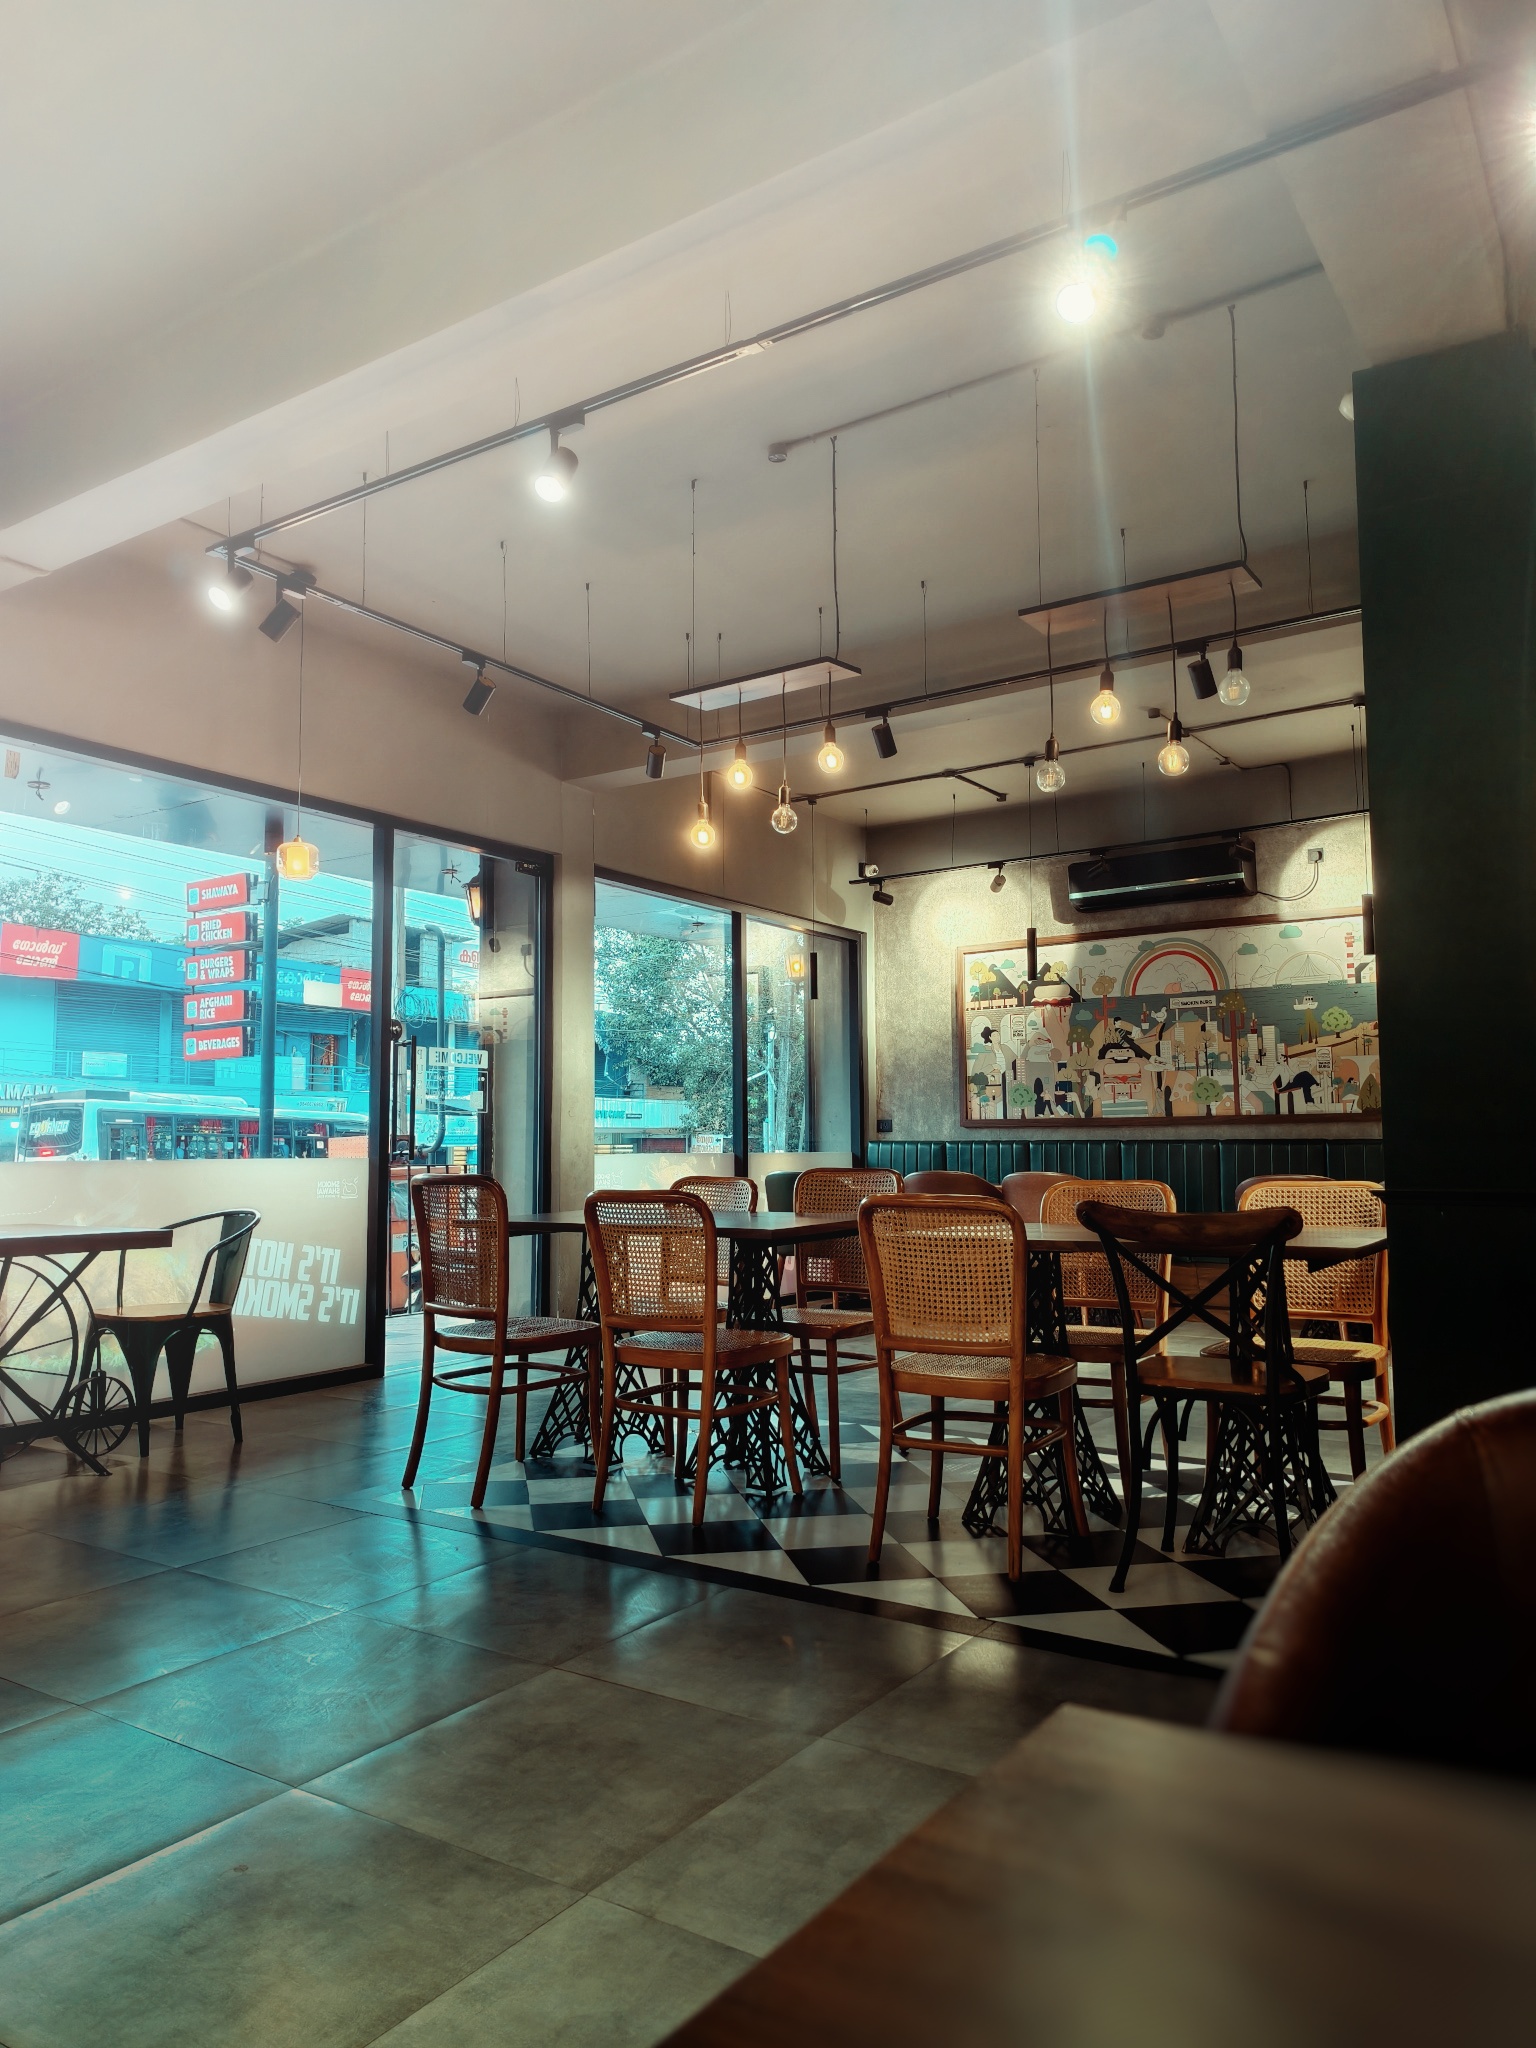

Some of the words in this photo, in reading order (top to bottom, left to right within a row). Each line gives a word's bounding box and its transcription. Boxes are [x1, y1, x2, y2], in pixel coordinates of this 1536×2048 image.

[201, 883, 238, 900] SHAWAYA
[201, 919, 222, 931] FRIED
[201, 928, 233, 942] CHICKEN
[200, 956, 234, 971] BURGERS
[200, 969, 206, 980] &
[208, 967, 234, 979] WRAPS
[200, 995, 233, 1009] AFGHANI
[200, 1008, 215, 1019] RICE
[198, 1036, 241, 1051] BEVERAGES
